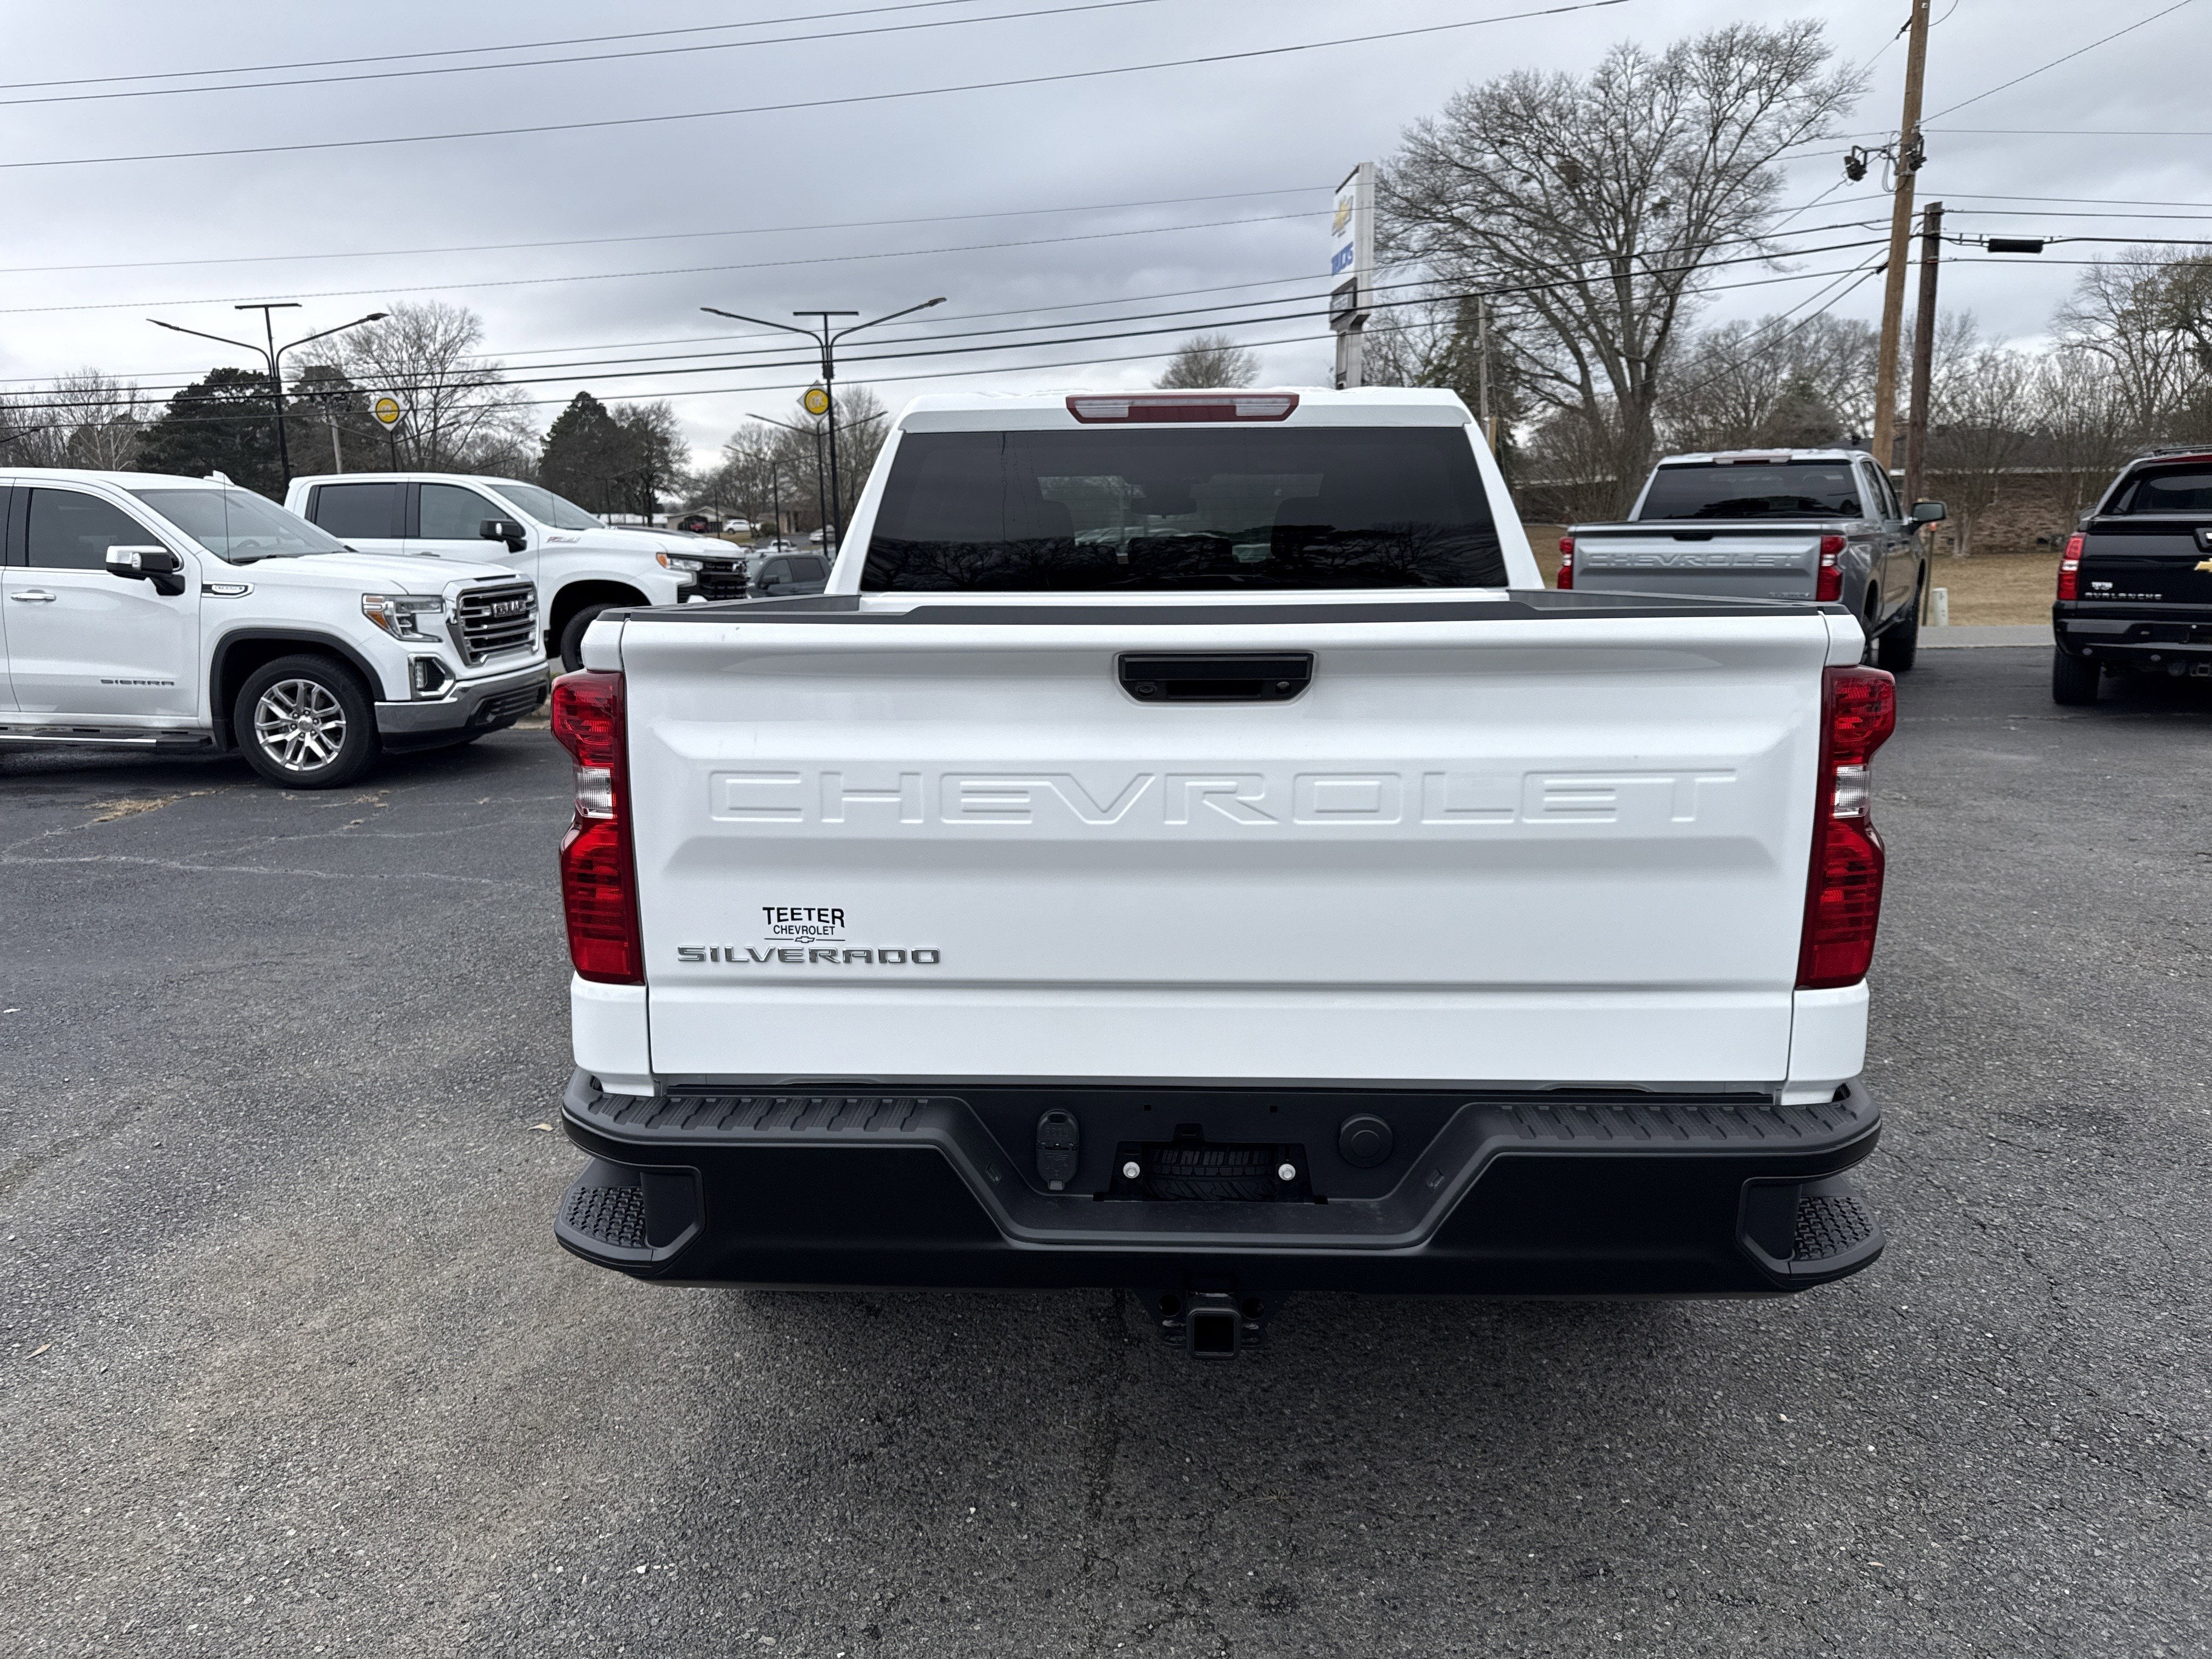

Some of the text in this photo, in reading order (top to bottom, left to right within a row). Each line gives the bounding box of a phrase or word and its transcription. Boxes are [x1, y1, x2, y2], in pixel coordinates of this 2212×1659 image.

[1588, 552, 1802, 568] CHEVROLET
[708, 768, 1737, 826] CHEVROLET
[762, 906, 845, 928] TEETER
[772, 924, 836, 935] CHEVROLET
[677, 945, 941, 964] SILVERADO
